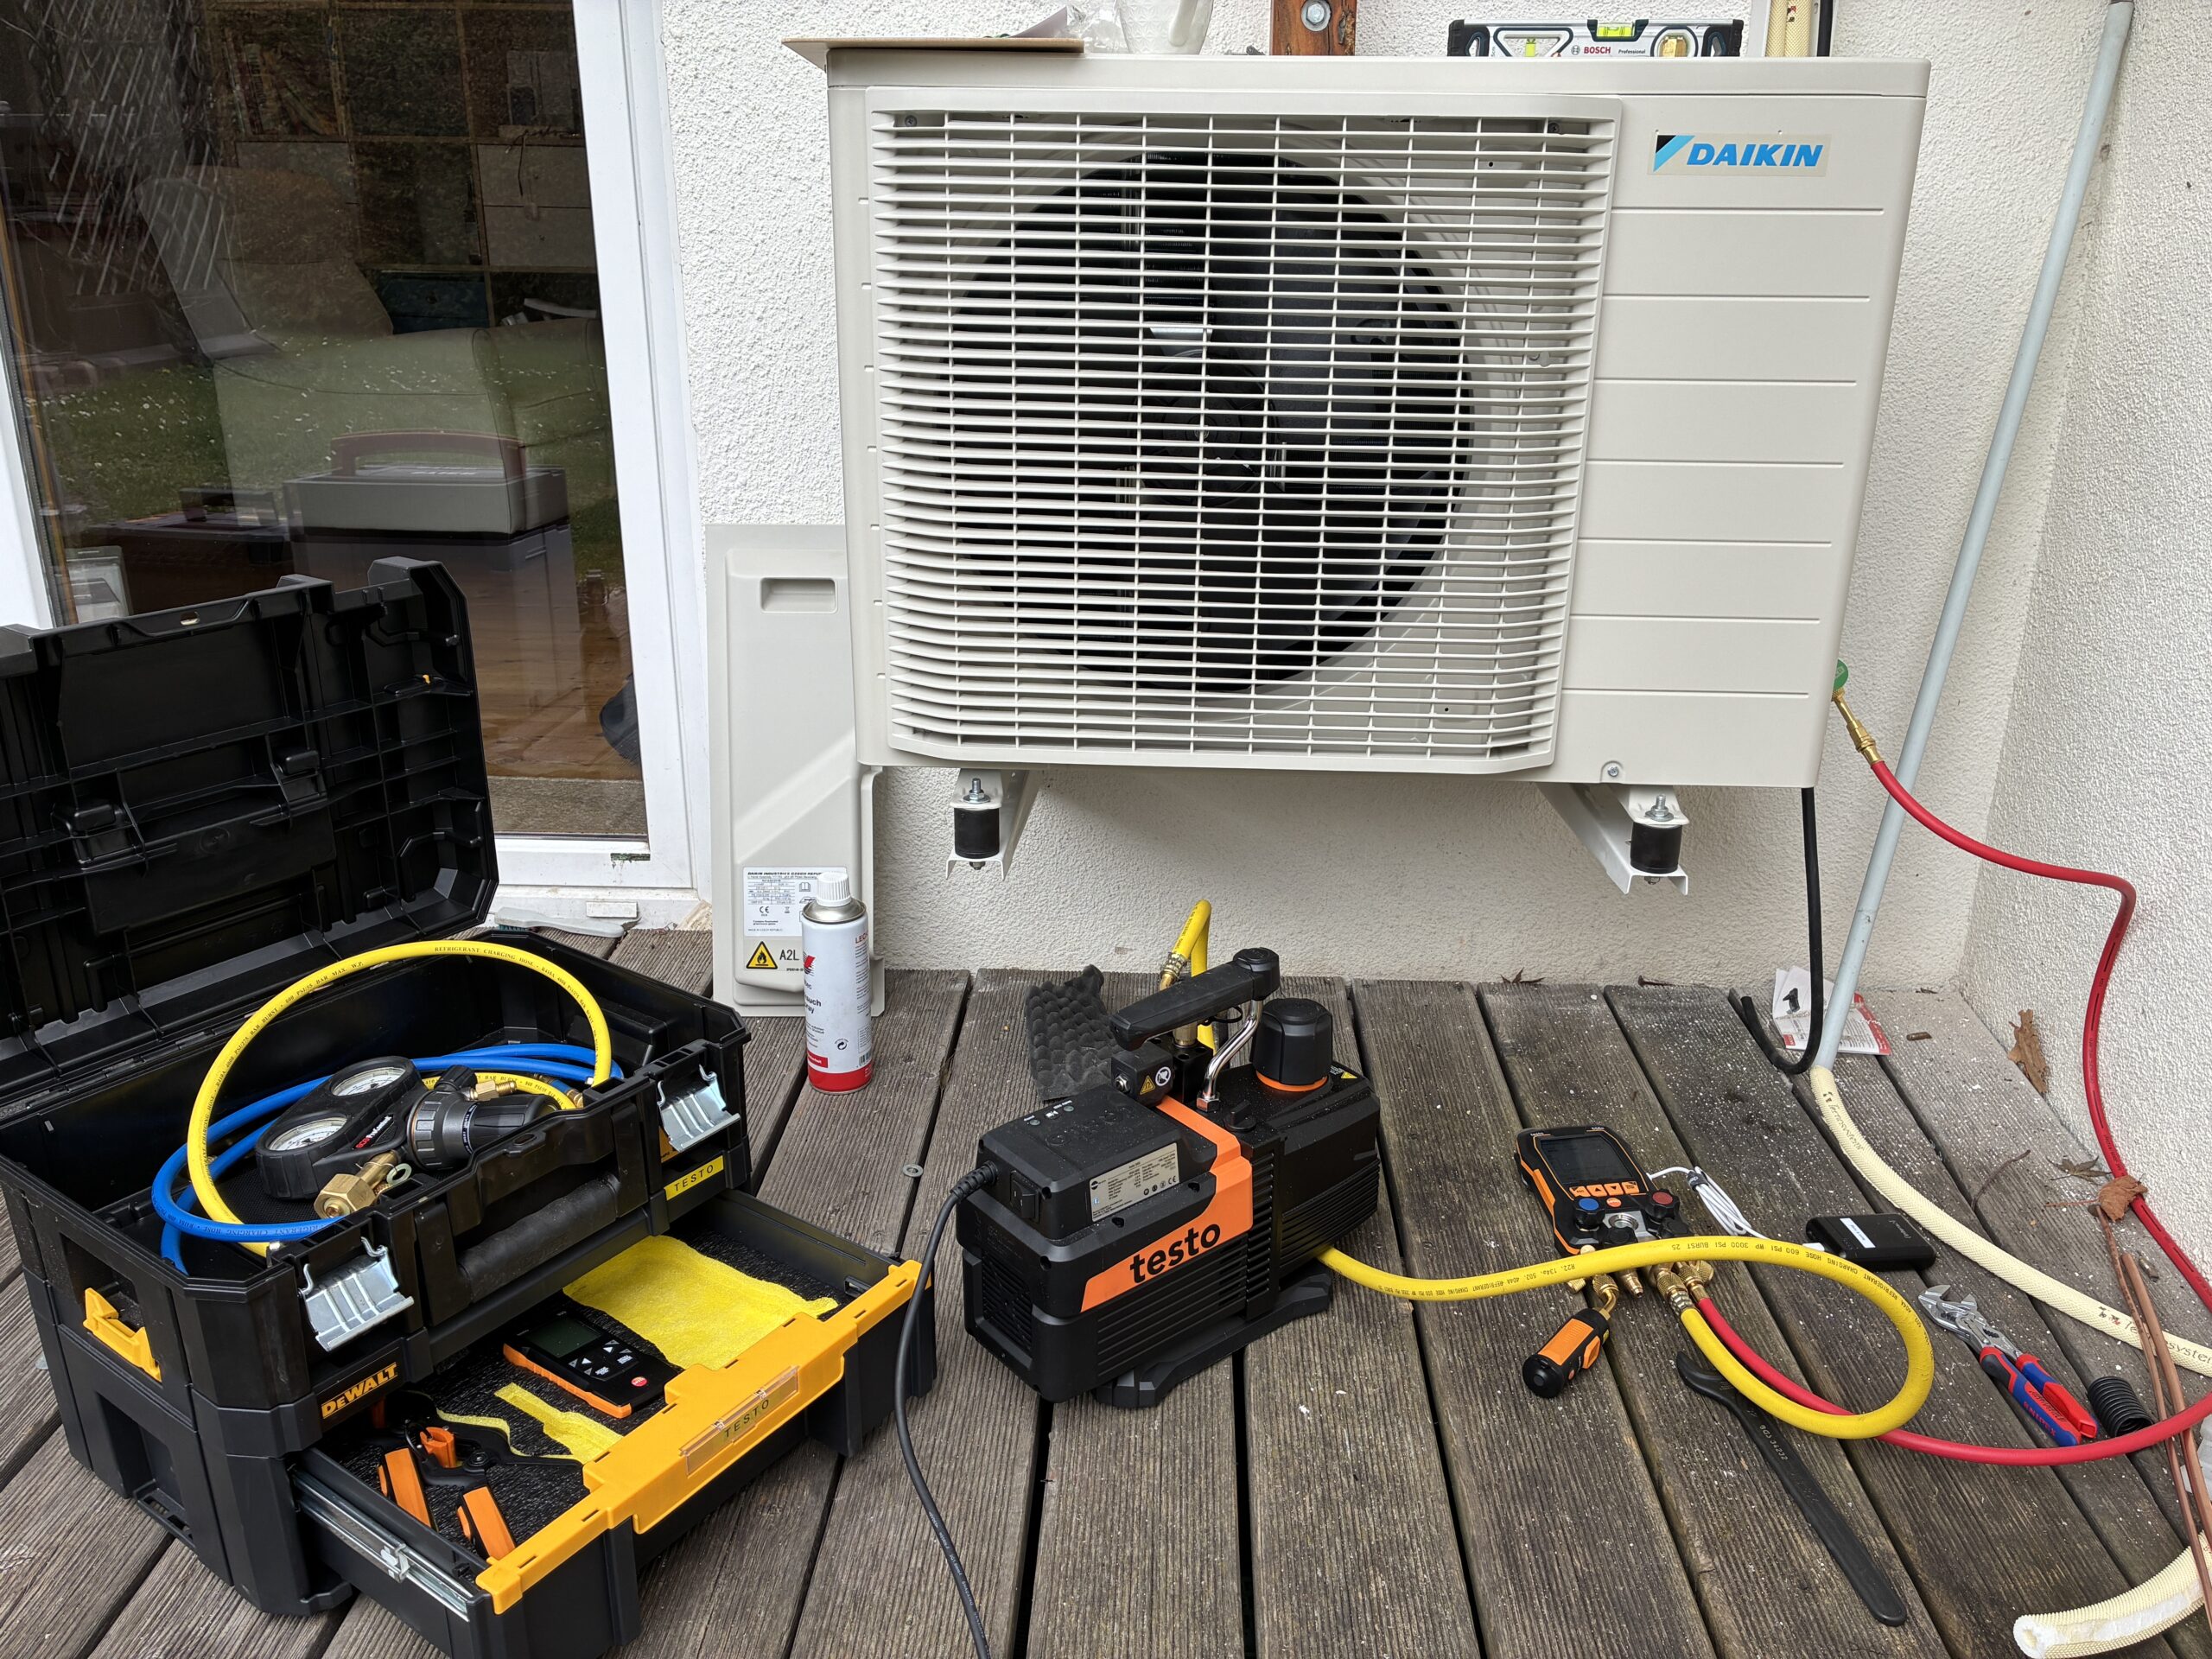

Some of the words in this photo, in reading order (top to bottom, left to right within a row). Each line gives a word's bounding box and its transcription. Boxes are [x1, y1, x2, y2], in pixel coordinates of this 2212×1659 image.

[1584, 46, 1611, 54] BOSCH
[1687, 143, 1824, 167] DAIKIN
[483, 949, 516, 960] CHARGING
[519, 957, 534, 967] HOSE
[779, 949, 799, 961] A2L
[250, 1024, 261, 1035] BAR
[262, 1007, 278, 1024] BURST
[296, 983, 313, 996] PSI/55
[315, 976, 328, 985] BAR
[674, 1164, 714, 1192] TESTO
[1129, 1224, 1221, 1283] testo
[1805, 1251, 1821, 1262] HOSE
[1827, 1257, 1859, 1274] CHARGING
[1448, 1287, 1468, 1295] CHARGING
[1472, 1281, 1503, 1292] REFRIGERANT
[1863, 1273, 1898, 1300] REFRIGERANT
[724, 1399, 769, 1438] TESTO
[2024, 1401, 2056, 1436] KNIPEX
